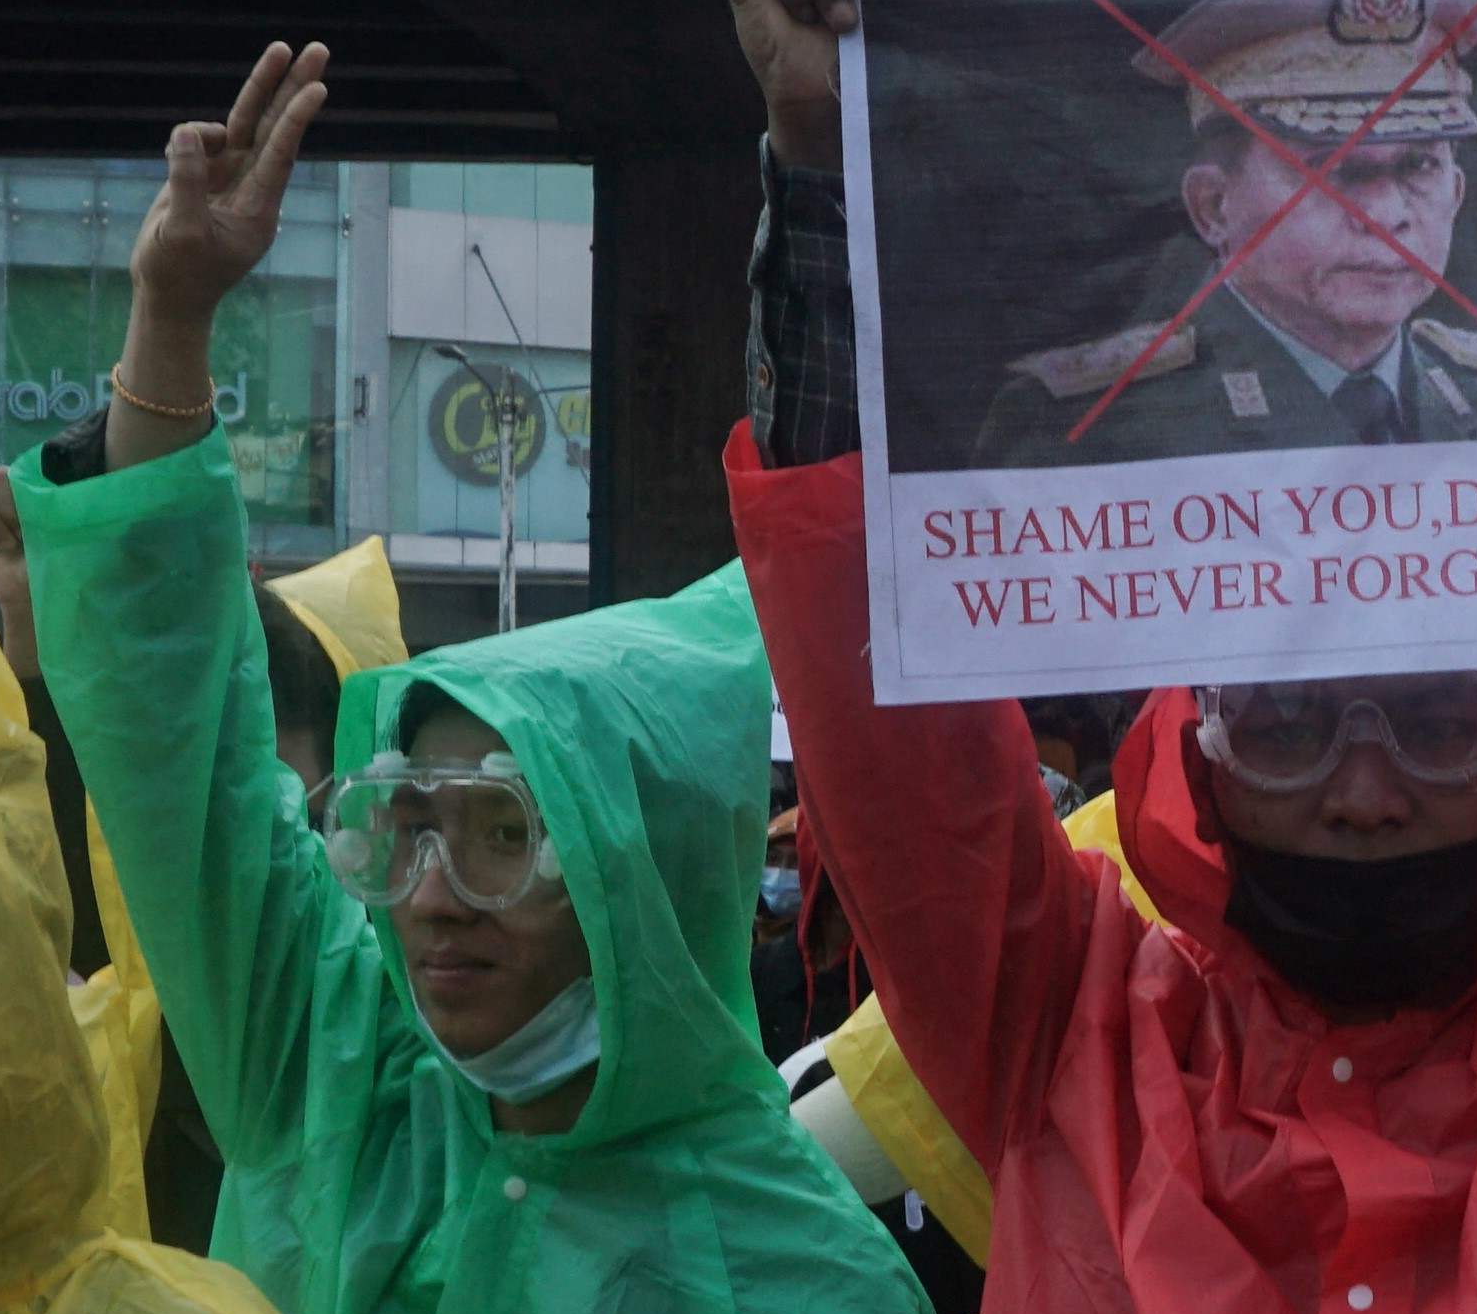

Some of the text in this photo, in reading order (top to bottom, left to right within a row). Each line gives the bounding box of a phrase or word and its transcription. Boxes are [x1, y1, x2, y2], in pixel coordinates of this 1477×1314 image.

[923, 498, 1154, 561] SHAME
[1174, 489, 1262, 544] ON
[952, 575, 1058, 628] WE
[1076, 558, 1293, 624] NEVER
